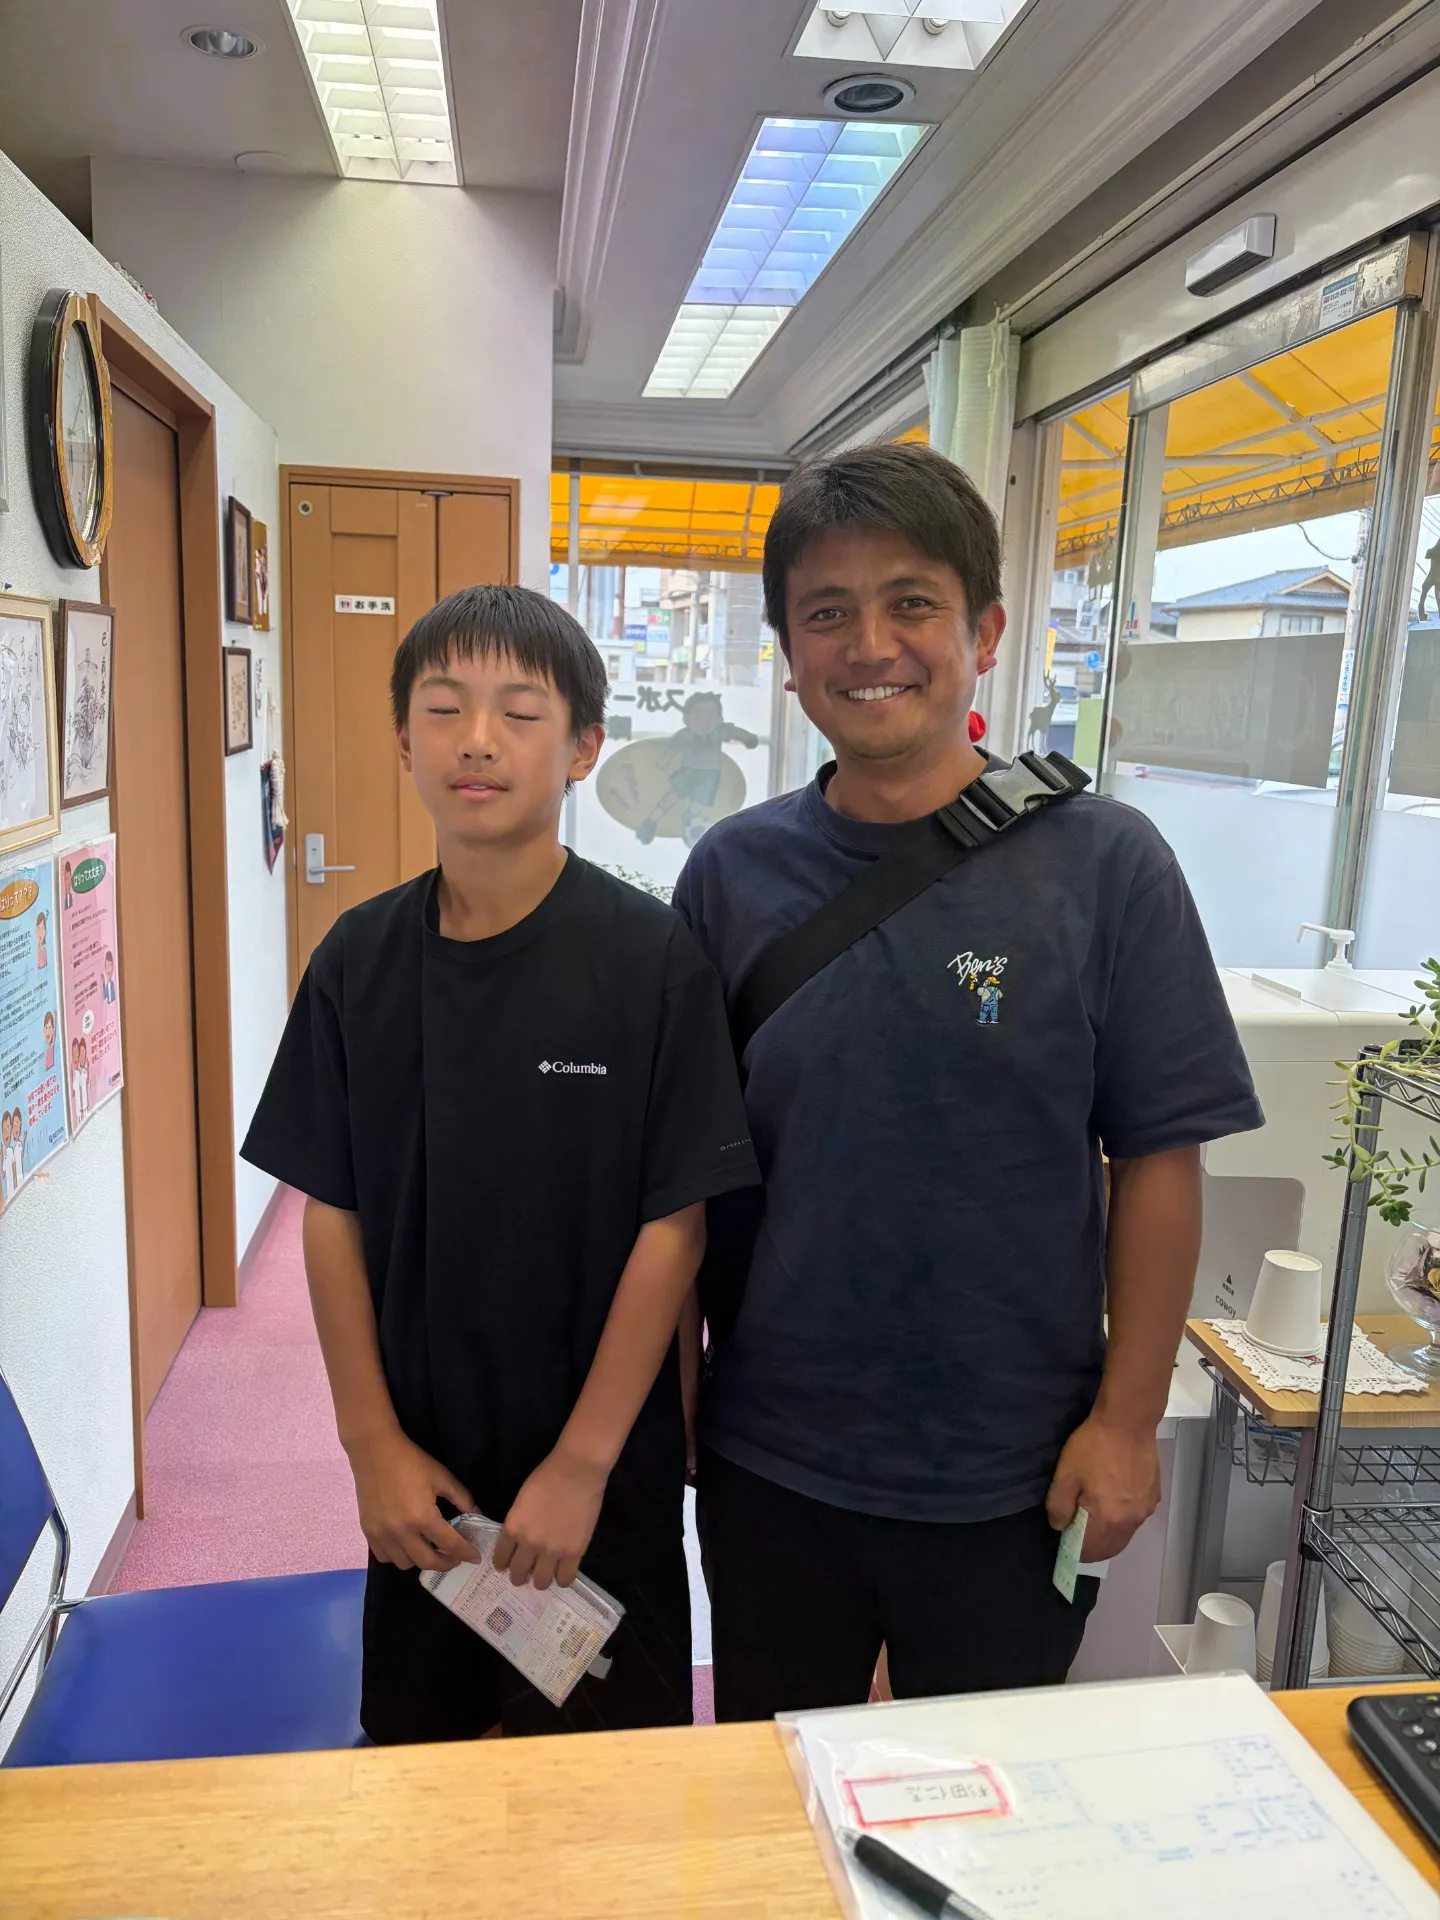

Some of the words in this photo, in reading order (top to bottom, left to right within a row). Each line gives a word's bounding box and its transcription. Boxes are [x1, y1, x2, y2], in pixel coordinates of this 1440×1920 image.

[354, 600, 391, 611] お手洗
[552, 1061, 607, 1075] Columbia
